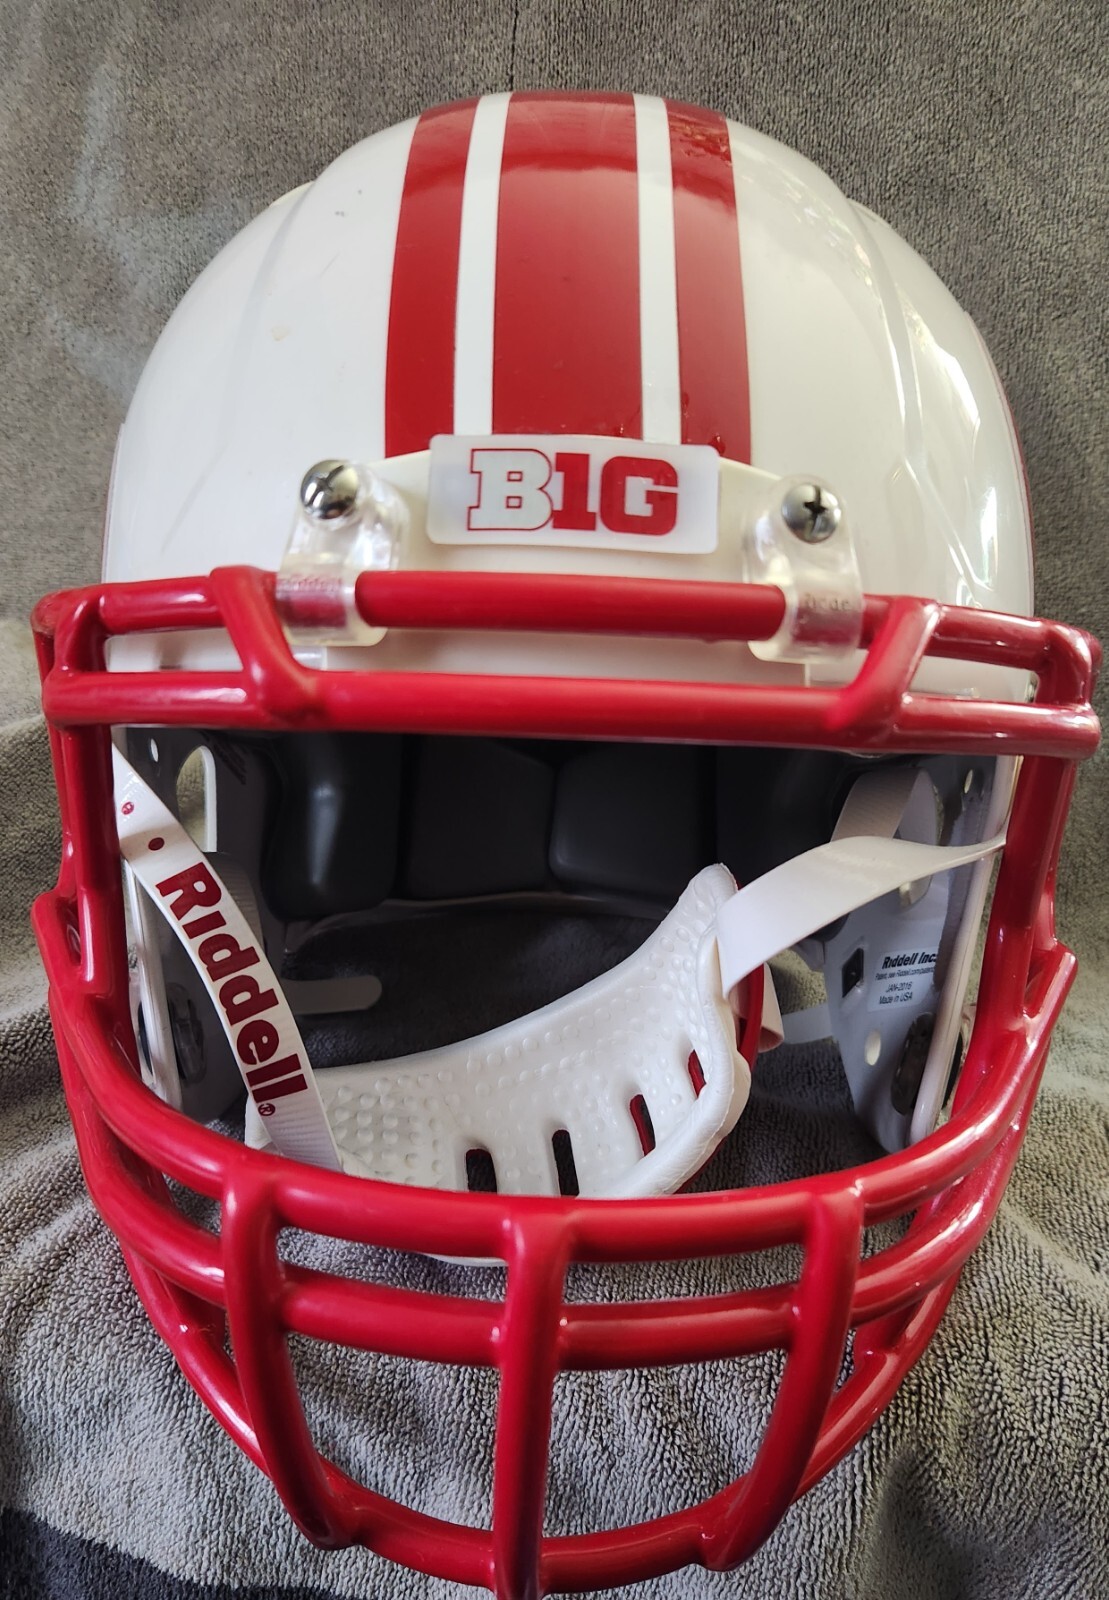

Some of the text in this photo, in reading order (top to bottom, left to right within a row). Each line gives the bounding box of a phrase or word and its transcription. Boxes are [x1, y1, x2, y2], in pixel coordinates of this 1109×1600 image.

[881, 952, 918, 969] Riddell
[879, 994, 893, 1004] Made
[900, 991, 913, 1002] USA
